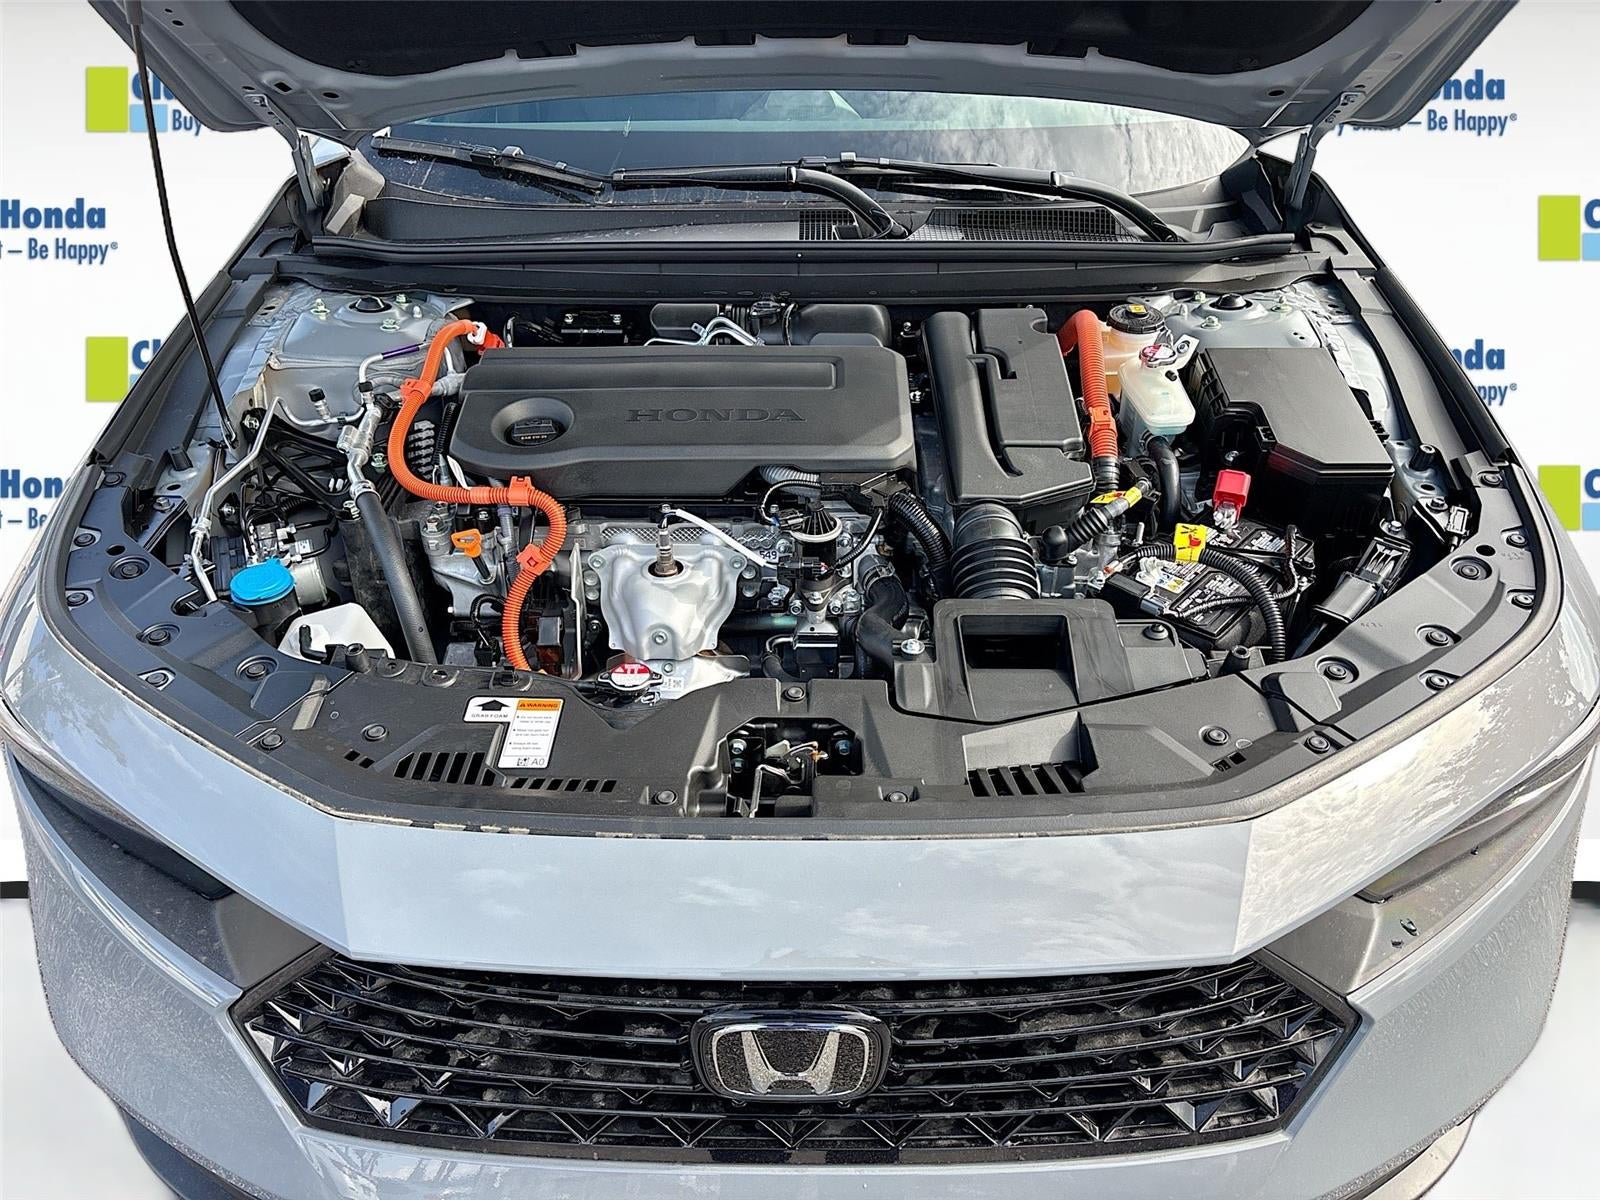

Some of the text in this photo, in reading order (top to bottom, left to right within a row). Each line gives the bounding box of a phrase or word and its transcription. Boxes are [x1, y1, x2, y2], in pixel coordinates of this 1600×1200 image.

[1429, 69, 1505, 100] nda
[172, 109, 202, 136] Buy
[1427, 109, 1448, 131] Be
[0, 198, 106, 229] Honda
[28, 237, 49, 260] Be
[625, 408, 807, 423] HONDA
[0, 469, 64, 499] Hon
